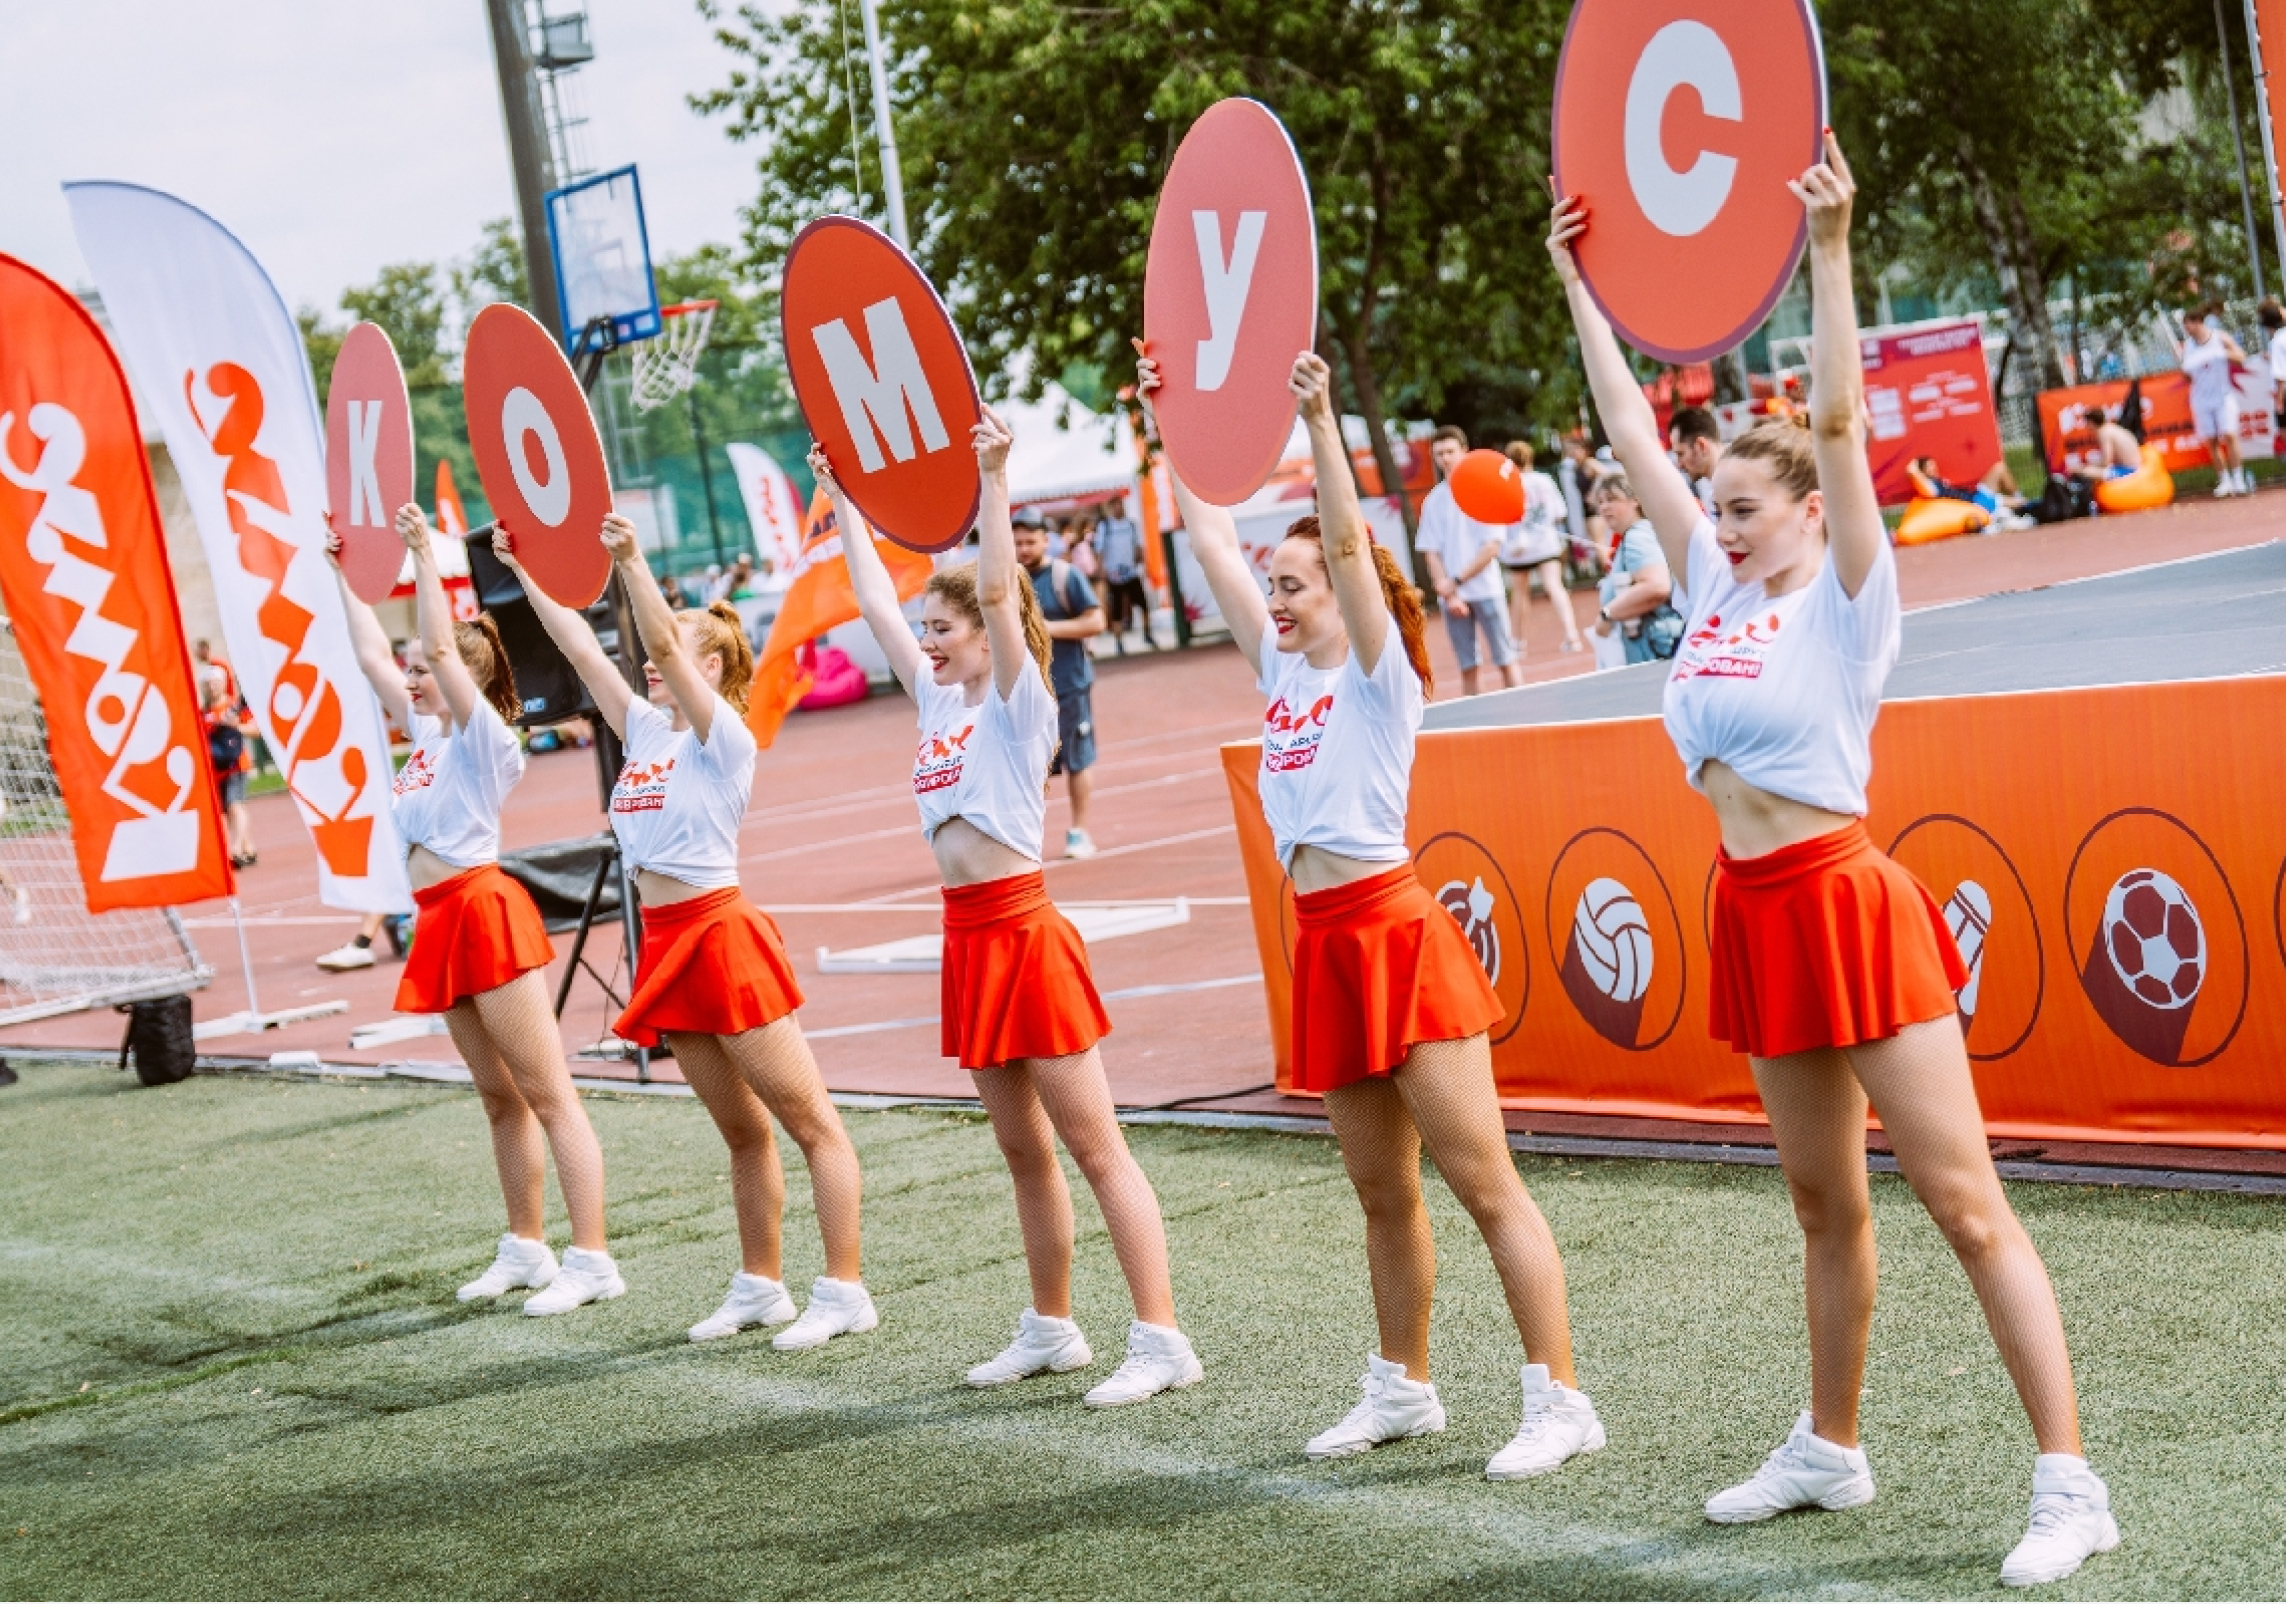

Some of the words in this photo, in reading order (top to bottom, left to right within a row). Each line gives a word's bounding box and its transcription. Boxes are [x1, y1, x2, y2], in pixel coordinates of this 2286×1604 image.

[812, 297, 950, 473] М
[347, 400, 387, 528] К
[502, 386, 571, 526] О
